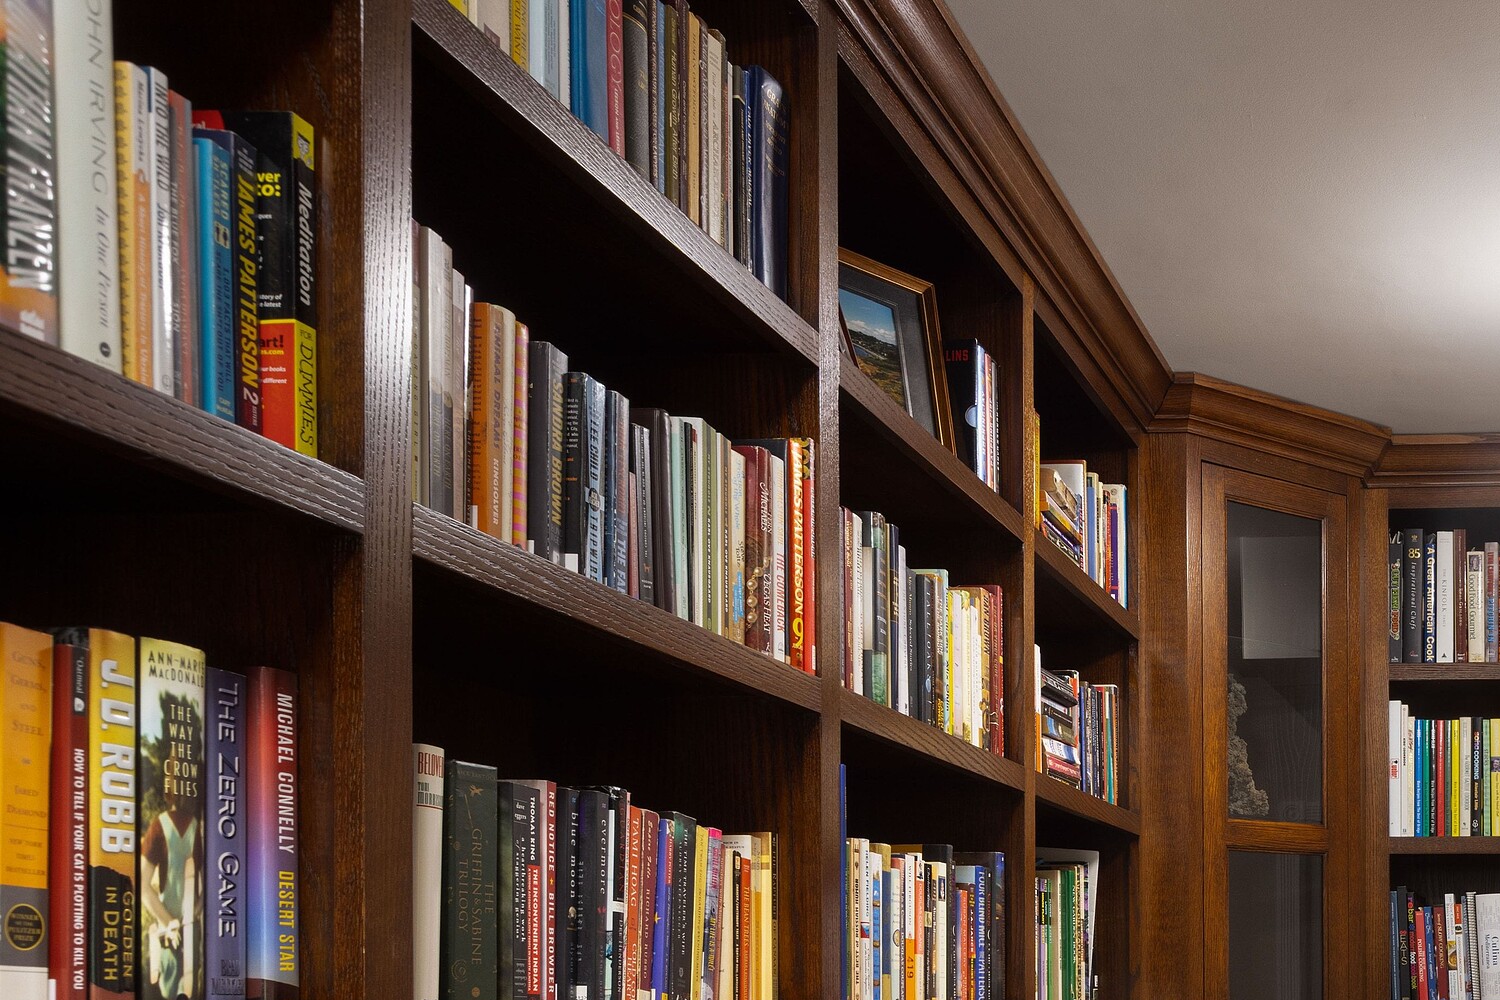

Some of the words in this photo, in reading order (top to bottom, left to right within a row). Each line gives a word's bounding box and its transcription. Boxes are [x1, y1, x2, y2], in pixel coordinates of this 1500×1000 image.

[155, 82, 169, 119] INTO
[156, 122, 169, 152] THE
[156, 154, 170, 191] WILD
[237, 175, 256, 252] JAMES
[298, 182, 314, 306] Meditation
[238, 255, 259, 389] PATTERSON
[300, 330, 313, 341] FOR
[945, 349, 969, 362] LINS
[299, 344, 314, 447] DUMMIES
[551, 382, 564, 454] SANDRA
[589, 419, 600, 446] LEE
[589, 446, 600, 482] CHILD
[793, 452, 804, 507] JAMES
[551, 455, 564, 527] BROWN
[776, 552, 785, 574] THE
[793, 509, 804, 615] PATTERSON
[1408, 547, 1421, 559] 85
[1426, 547, 1435, 555] A
[1425, 556, 1435, 585] Great
[776, 575, 786, 632] COMEBACK
[1425, 586, 1435, 634] American
[1425, 636, 1435, 662] Cook
[101, 659, 135, 688] J.
[101, 699, 135, 730] D.
[169, 703, 193, 723] THE
[218, 683, 239, 743] THE
[277, 692, 294, 764] MICHAEL
[168, 722, 195, 742] WAY
[169, 741, 194, 760] THE
[163, 758, 199, 779] CROW
[101, 742, 135, 854] ROBB
[163, 779, 199, 799] FLIES
[217, 752, 240, 840] ZERO
[547, 791, 555, 819] RED
[278, 771, 294, 854] CONNELLY
[569, 812, 579, 847] blue
[547, 823, 555, 872] NOTICE
[630, 817, 640, 848] TAMI
[598, 818, 607, 896] evermore
[106, 886, 119, 903] IN
[217, 851, 240, 938] GAME
[531, 868, 539, 886] THE
[569, 855, 579, 899] moon
[629, 855, 640, 897] HOAG
[978, 870, 986, 896] FOUR
[279, 871, 295, 929] DESERT
[458, 858, 470, 934] TRILOGY
[484, 881, 495, 914] THE
[547, 892, 556, 922] BILL
[122, 890, 134, 977] GOLDEN
[531, 886, 539, 955] INCONVENIENT
[104, 911, 121, 980] DEATH
[280, 935, 296, 972] STAR
[547, 927, 556, 994] BROWDER
[1490, 936, 1499, 966] Culina
[531, 955, 539, 992] INDIAN
[905, 956, 914, 979] 419
